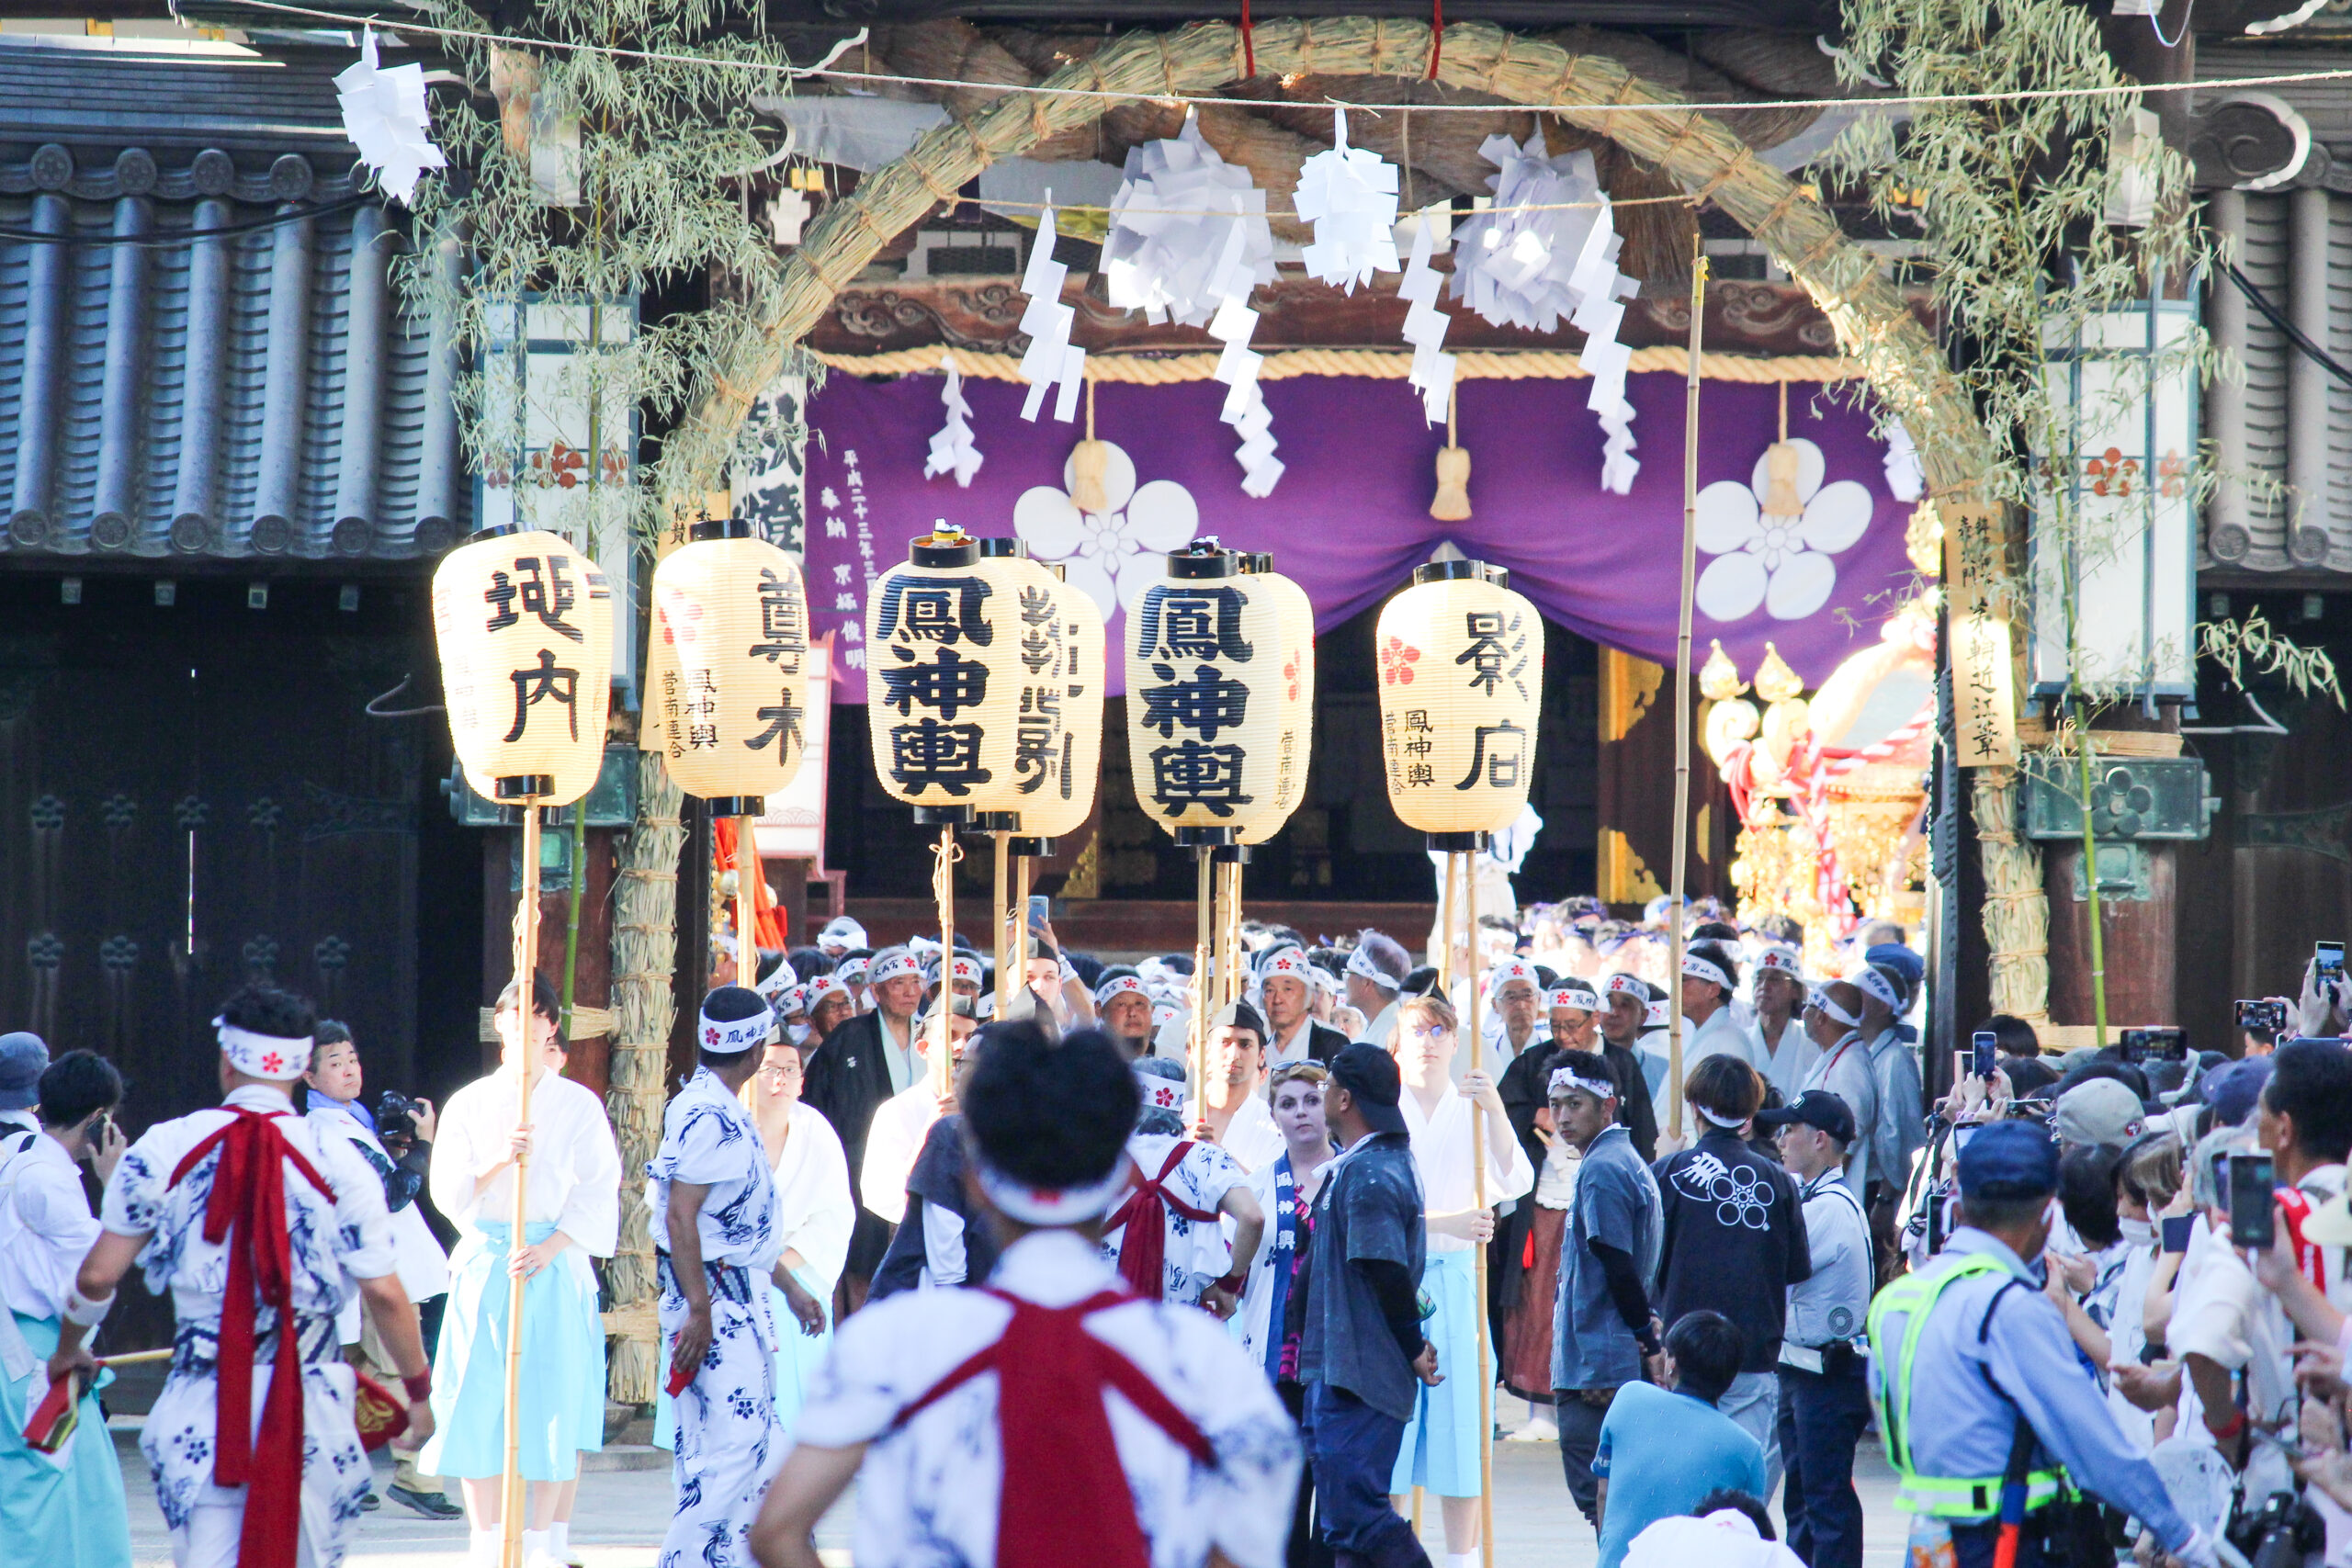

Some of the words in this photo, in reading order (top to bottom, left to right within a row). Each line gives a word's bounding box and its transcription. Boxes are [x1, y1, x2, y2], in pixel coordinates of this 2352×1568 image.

[876, 574, 993, 796] 鳳神輿
[1137, 585, 1254, 818] 鳳神輿
[1404, 709, 1435, 788] 鳳神輿
